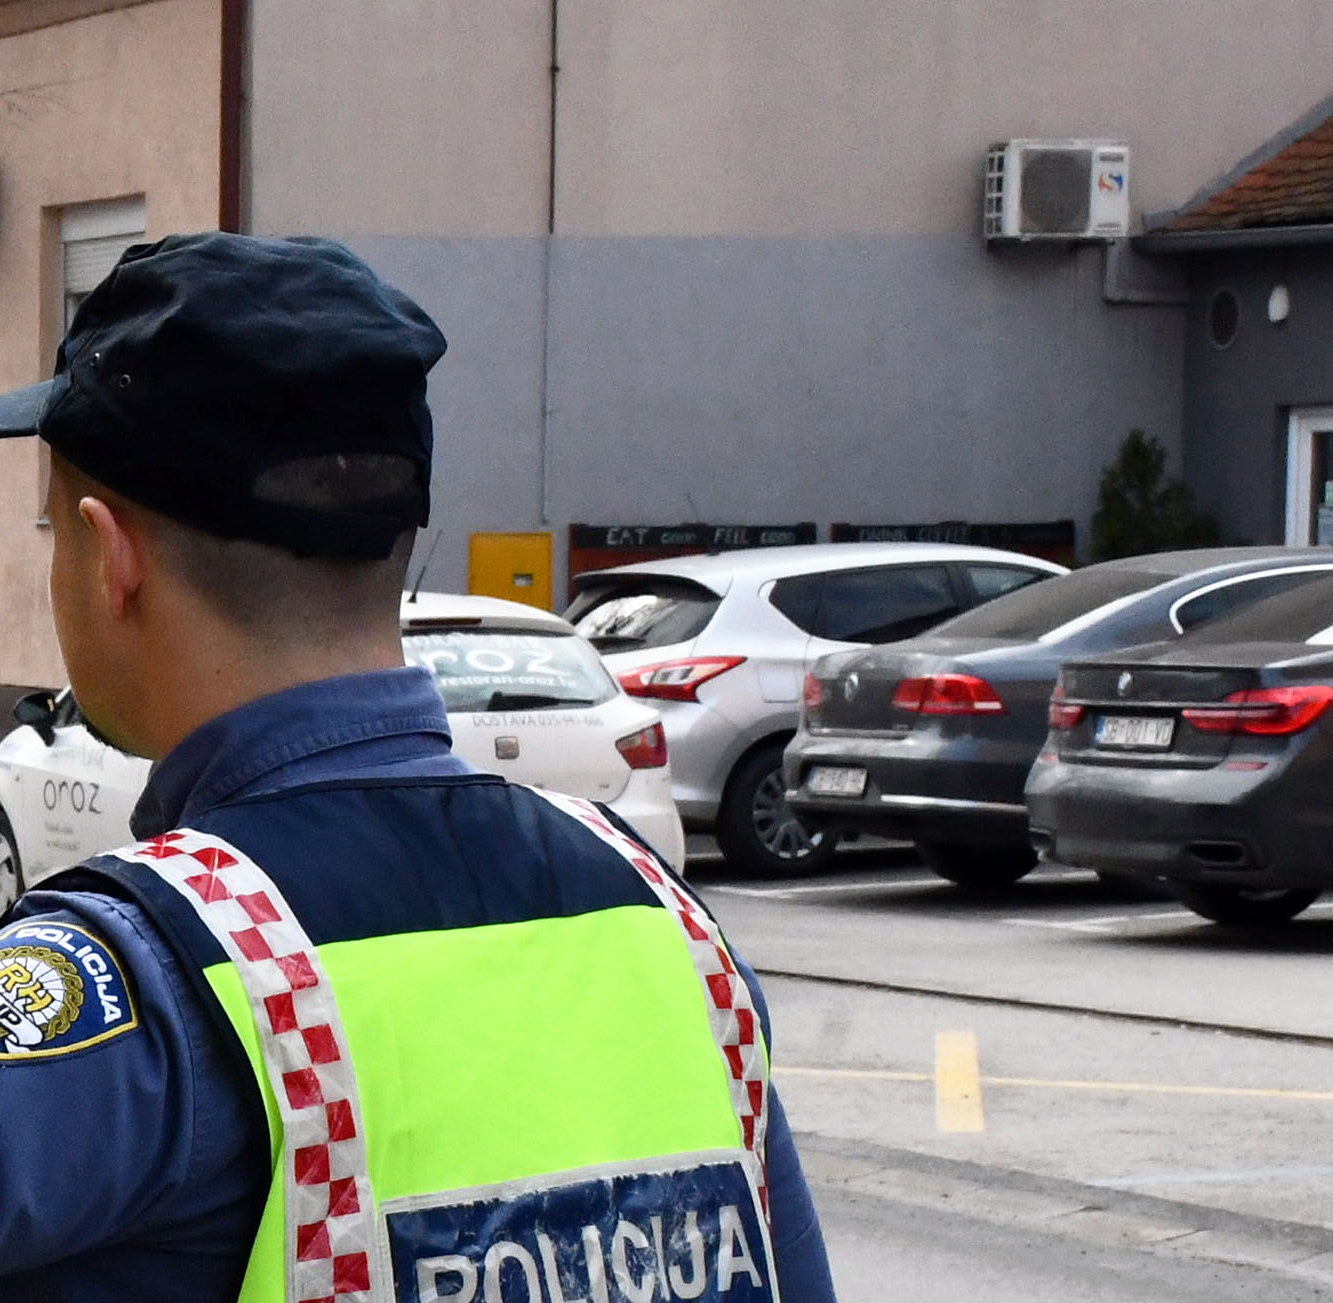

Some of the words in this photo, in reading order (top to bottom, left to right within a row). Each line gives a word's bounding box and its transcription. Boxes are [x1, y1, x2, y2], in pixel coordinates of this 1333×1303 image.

[405, 649, 573, 676] roz
[472, 714, 536, 727] DOSTAVA
[15, 926, 123, 1026] POLICIJA
